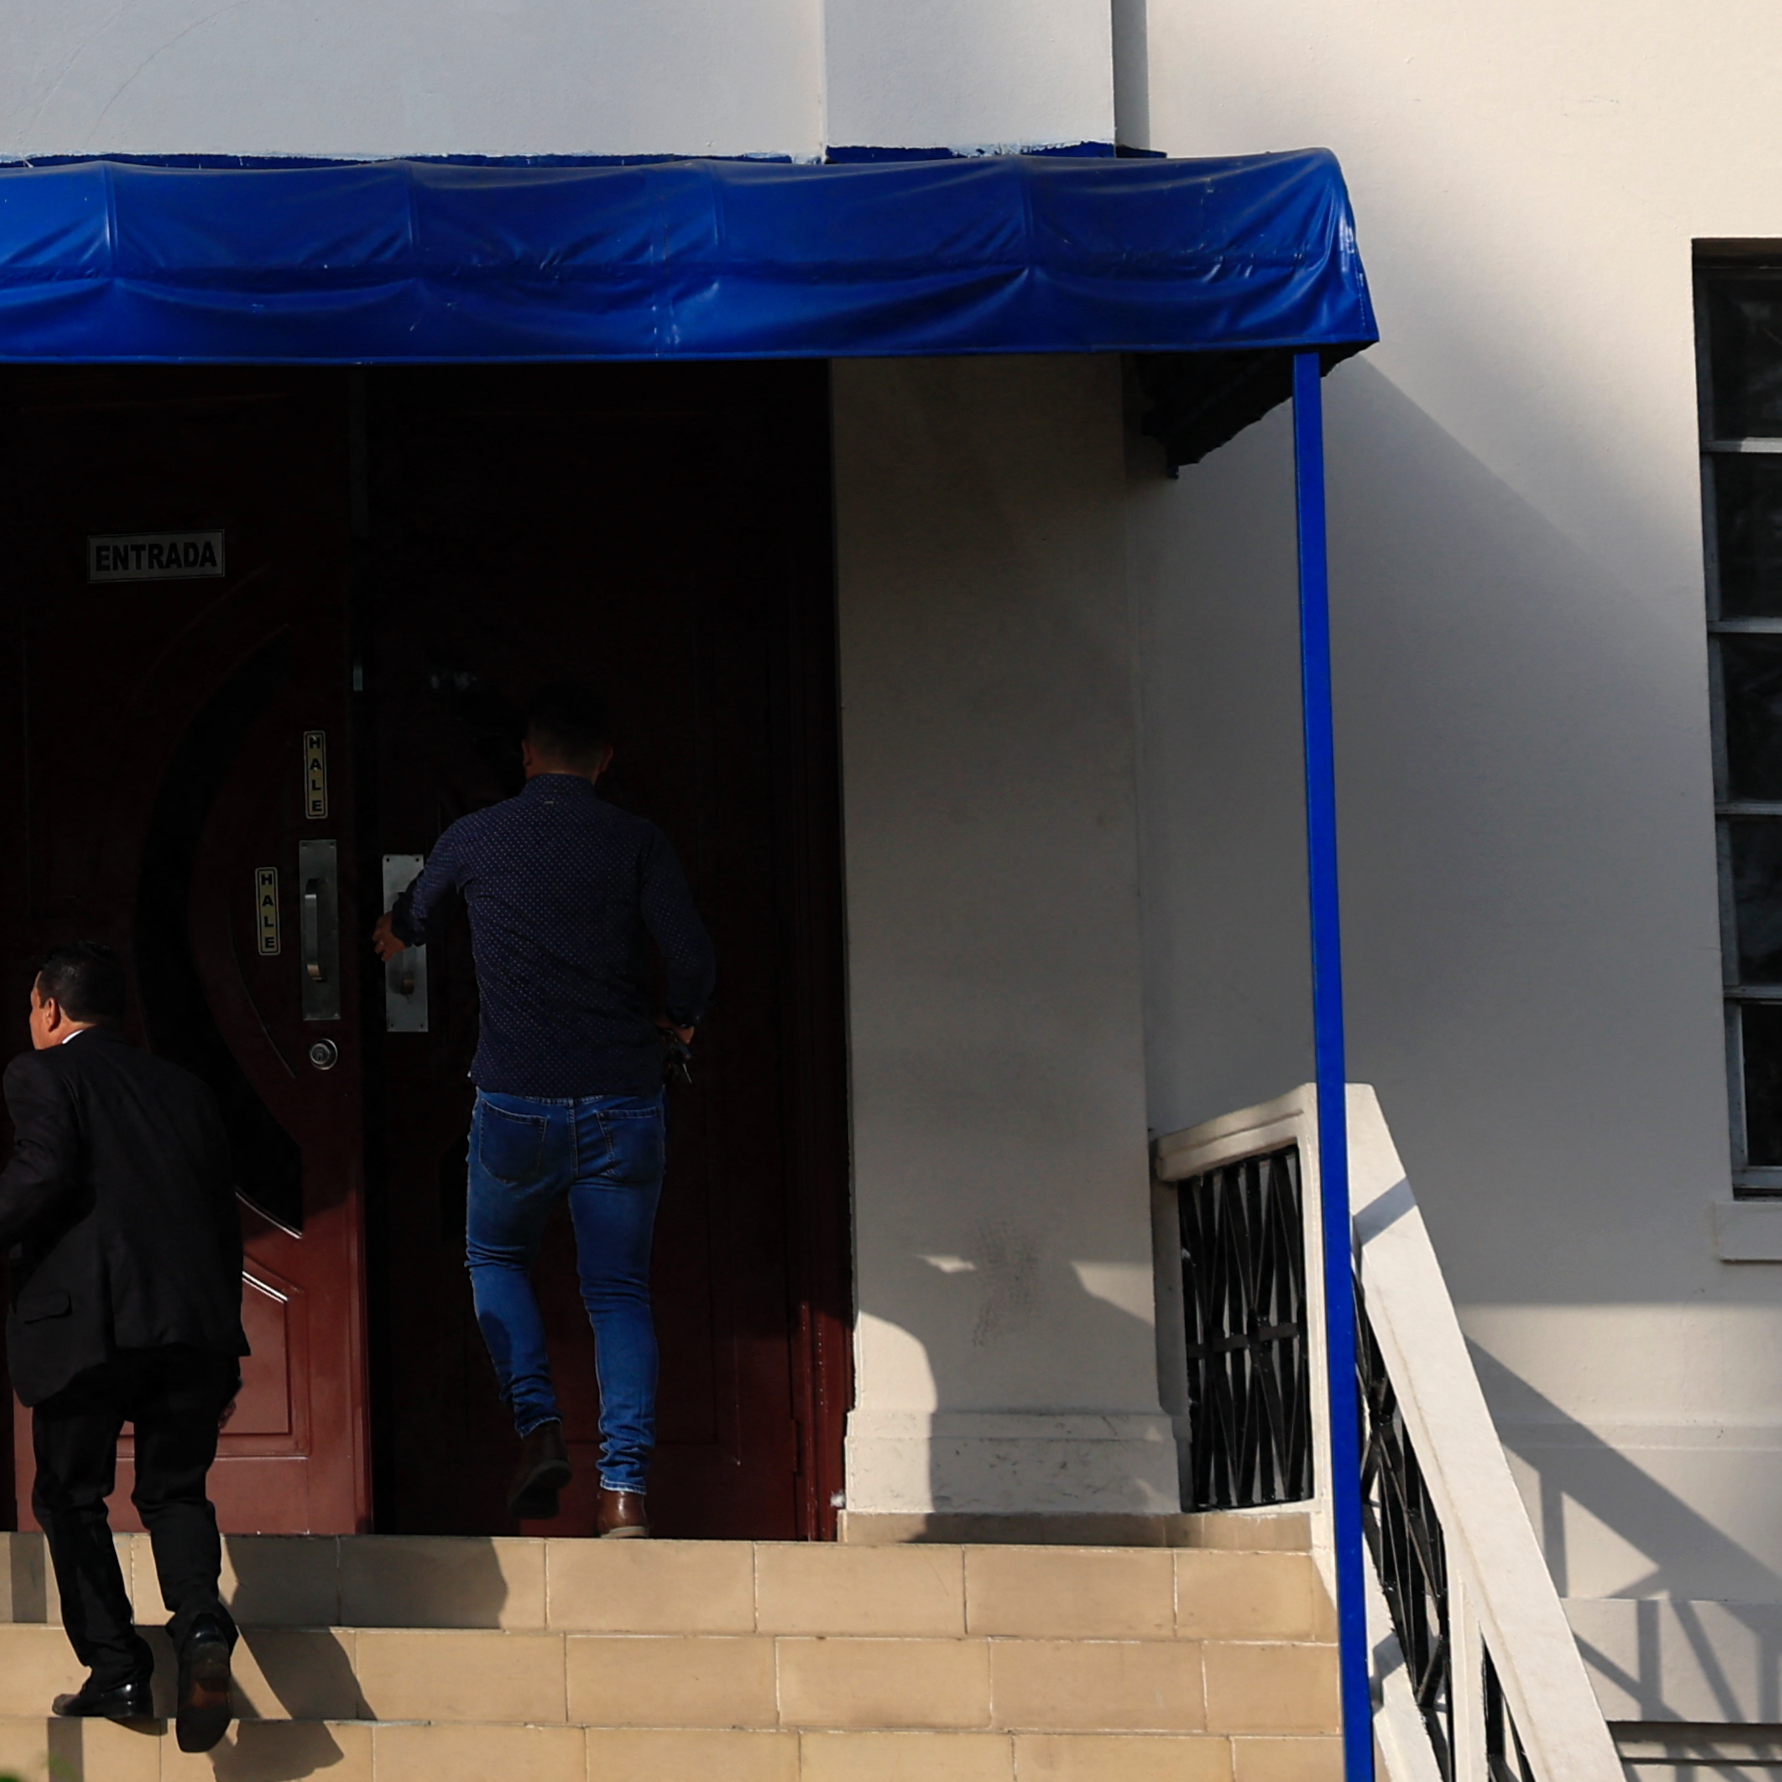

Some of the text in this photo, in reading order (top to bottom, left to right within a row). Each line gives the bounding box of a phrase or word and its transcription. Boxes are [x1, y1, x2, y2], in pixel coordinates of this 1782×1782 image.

[96, 541, 217, 572] ENTRADA
[309, 736, 322, 812] HALE
[261, 874, 275, 949] HALE
